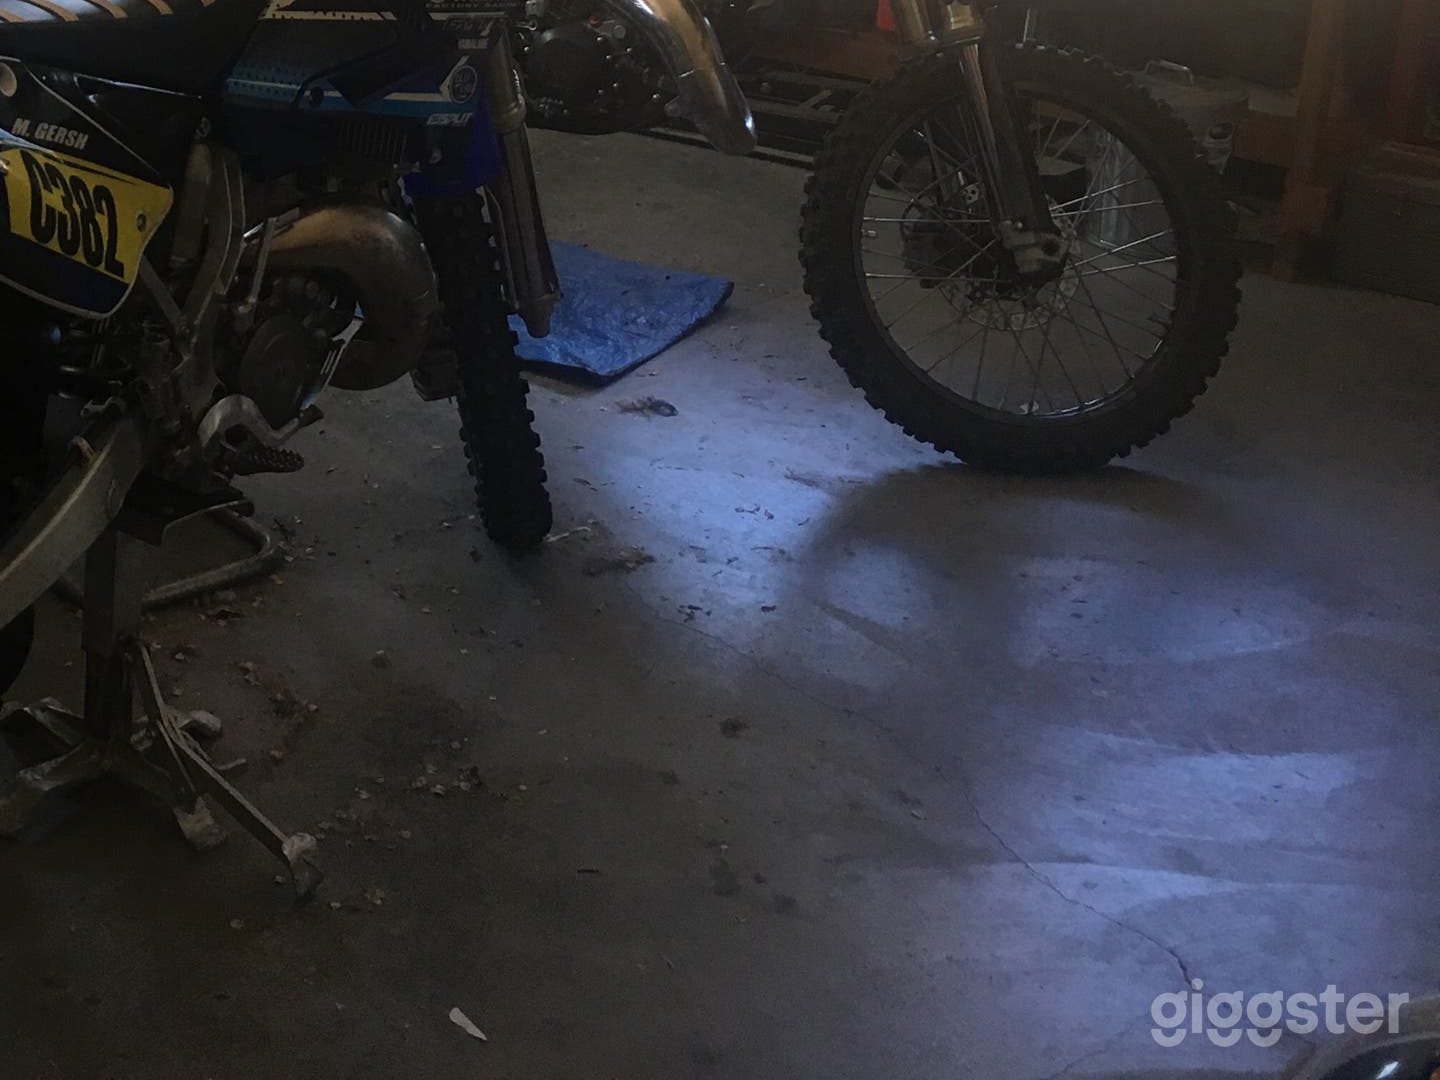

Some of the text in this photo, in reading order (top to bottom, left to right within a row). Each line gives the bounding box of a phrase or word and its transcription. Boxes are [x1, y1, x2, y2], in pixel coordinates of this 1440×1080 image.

[12, 117, 89, 150] M. GERSH
[20, 149, 124, 278] C382
